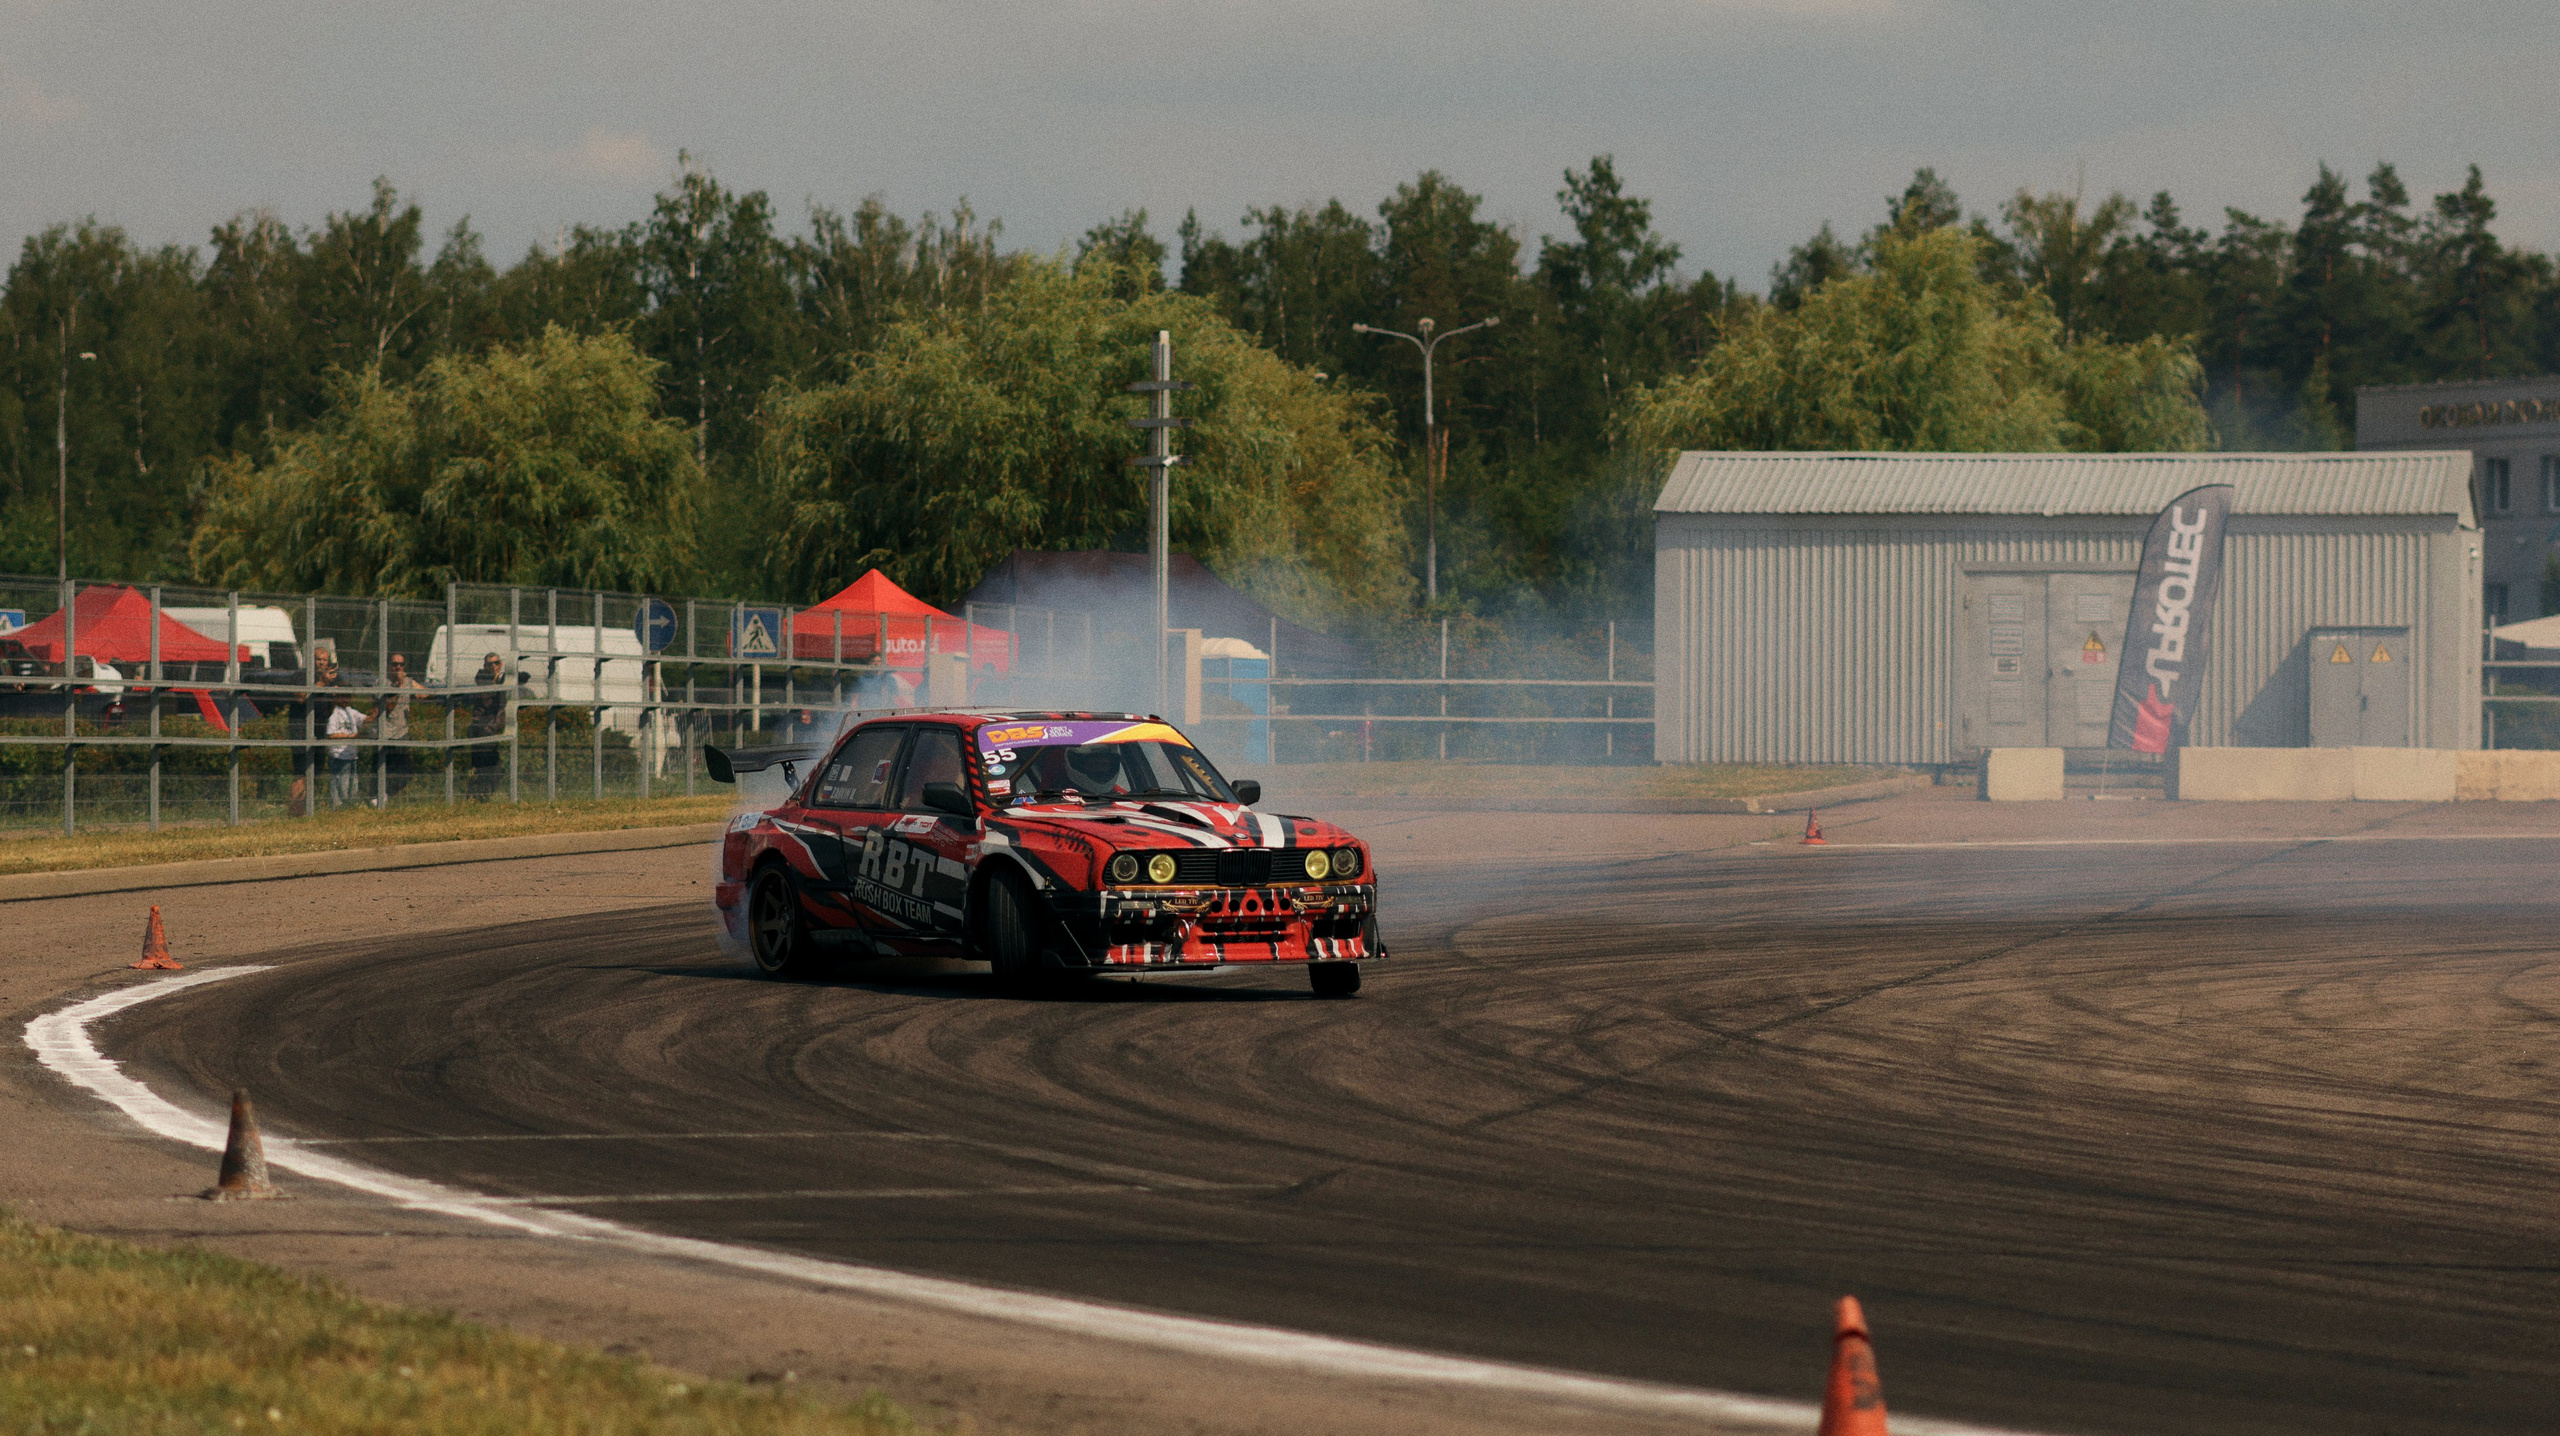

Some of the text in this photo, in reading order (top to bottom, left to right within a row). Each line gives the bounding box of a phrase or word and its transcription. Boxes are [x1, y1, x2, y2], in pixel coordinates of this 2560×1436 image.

[986, 726, 1045, 744] DBS
[982, 747, 1017, 765] 55
[858, 829, 937, 898] RBT
[854, 878, 932, 925] RUSH BOX TEAM
